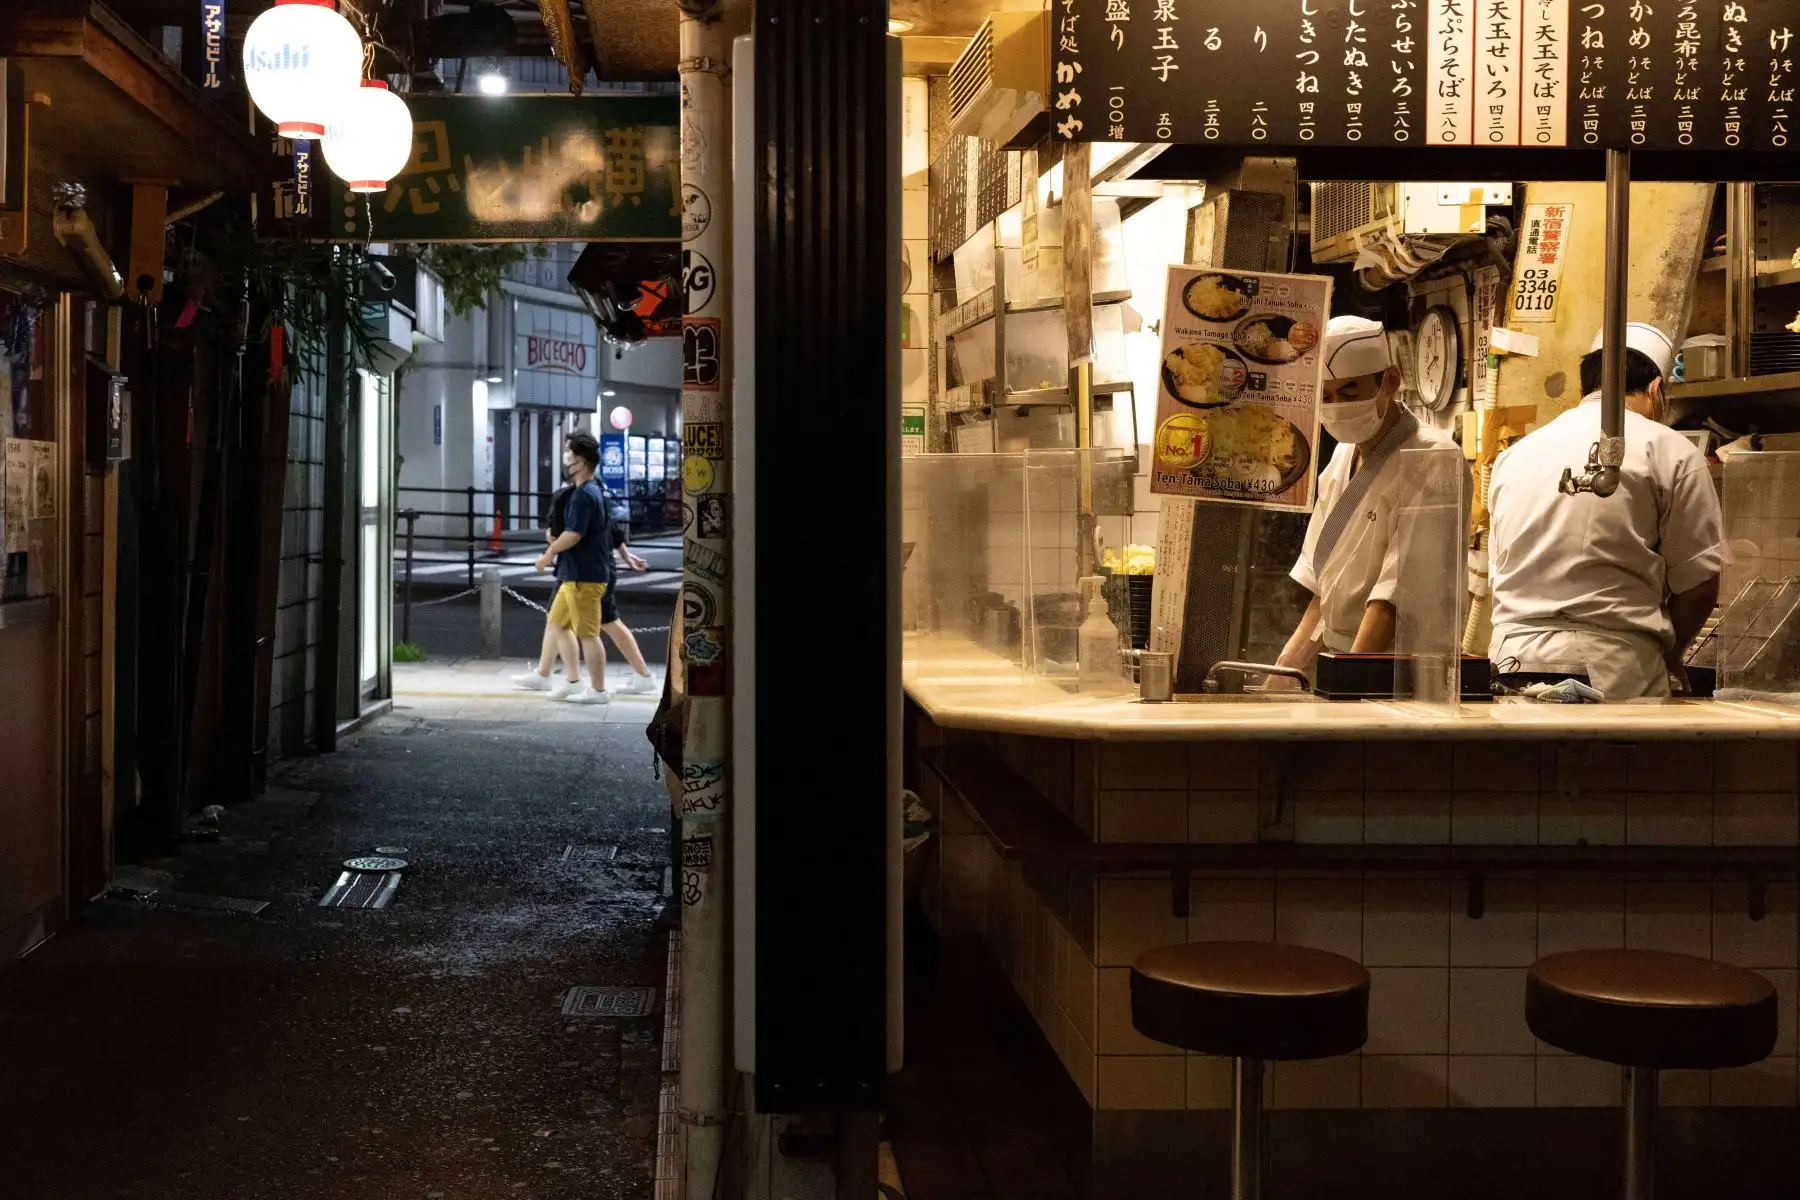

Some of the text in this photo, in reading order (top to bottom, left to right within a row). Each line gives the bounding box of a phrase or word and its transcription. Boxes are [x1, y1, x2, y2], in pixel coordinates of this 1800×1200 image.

[204, 5, 221, 88] アサヒビール
[1104, 0, 1131, 51] 盛り
[1581, 3, 1605, 49] つね
[1628, 0, 1653, 49] かめ
[1673, 0, 1702, 58] ろ昆布
[1722, 2, 1748, 53] ぬき
[1769, 27, 1794, 53] け
[1151, 0, 1180, 139] 泉玉子 五〇
[1203, 27, 1222, 140] る 三五〇
[1251, 25, 1268, 140] り 二八〇
[1295, 0, 1320, 141] しきつね 四二〇
[1343, 0, 1369, 141] したぬき 四二〇
[1438, 0, 1466, 142] 天ぷらそば 三八〇
[1485, 2, 1512, 143] 天玉せいろ 四三〇
[1055, 61, 1083, 139] かめや
[1394, 102, 1411, 142] 三八〇
[1536, 106, 1552, 143] 四三〇
[1583, 105, 1600, 144] 三四〇
[1631, 105, 1647, 145] 三四〇
[1678, 106, 1694, 145] 三四〇
[1725, 107, 1741, 146] 三四〇
[1772, 108, 1789, 146] 二八〇
[295, 152, 309, 214] アサヒビール
[1526, 219, 1541, 254] 直通電話
[1538, 206, 1566, 265] 新宿警察署
[1517, 280, 1557, 293] 3346
[1524, 269, 1549, 279] 03
[1515, 294, 1554, 310] 0110
[1478, 336, 1488, 346] 03
[1156, 471, 1275, 492] Ten-Tama Soba ¥430
